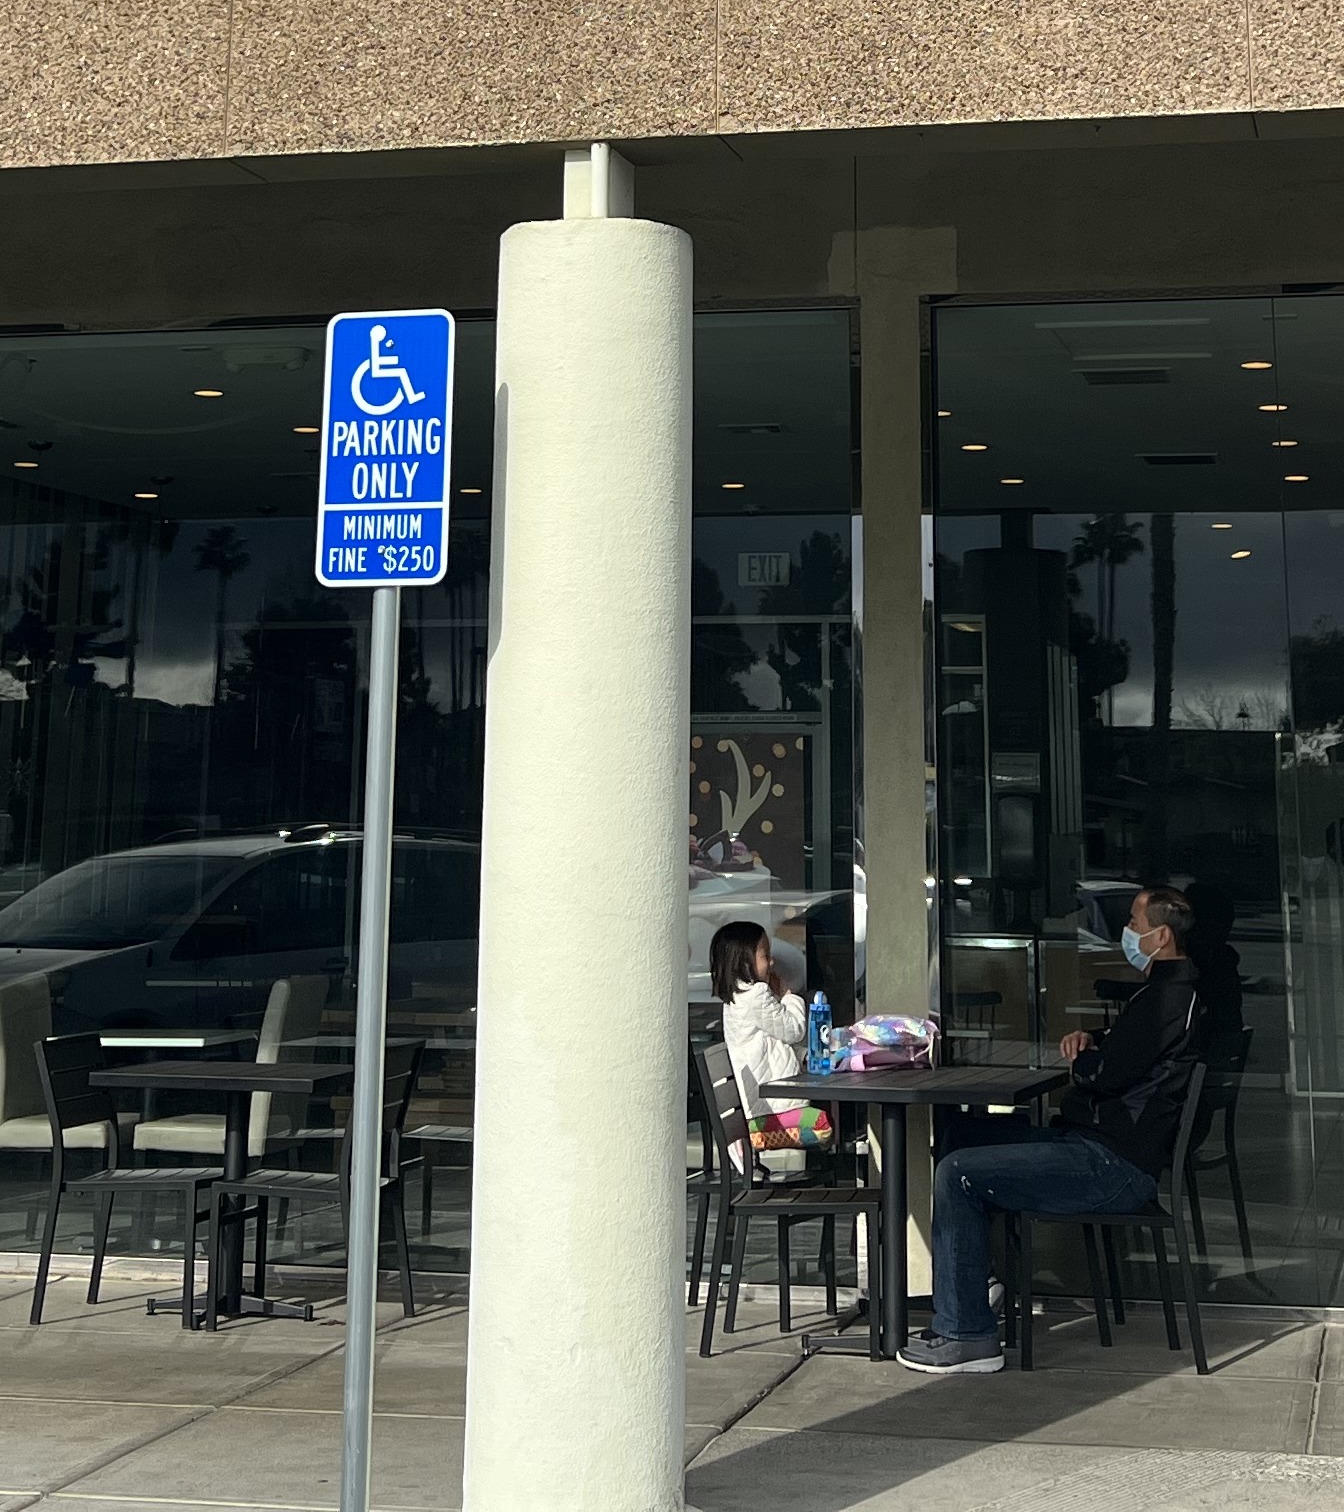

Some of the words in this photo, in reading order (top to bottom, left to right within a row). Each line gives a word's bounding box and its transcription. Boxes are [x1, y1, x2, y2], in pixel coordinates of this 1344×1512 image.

[332, 418, 441, 457] PARKING
[352, 462, 420, 500] ONLY
[343, 514, 422, 540] MINIMUM
[328, 547, 367, 573] FINE
[383, 544, 434, 574] $250
[747, 554, 783, 583] EXIT
